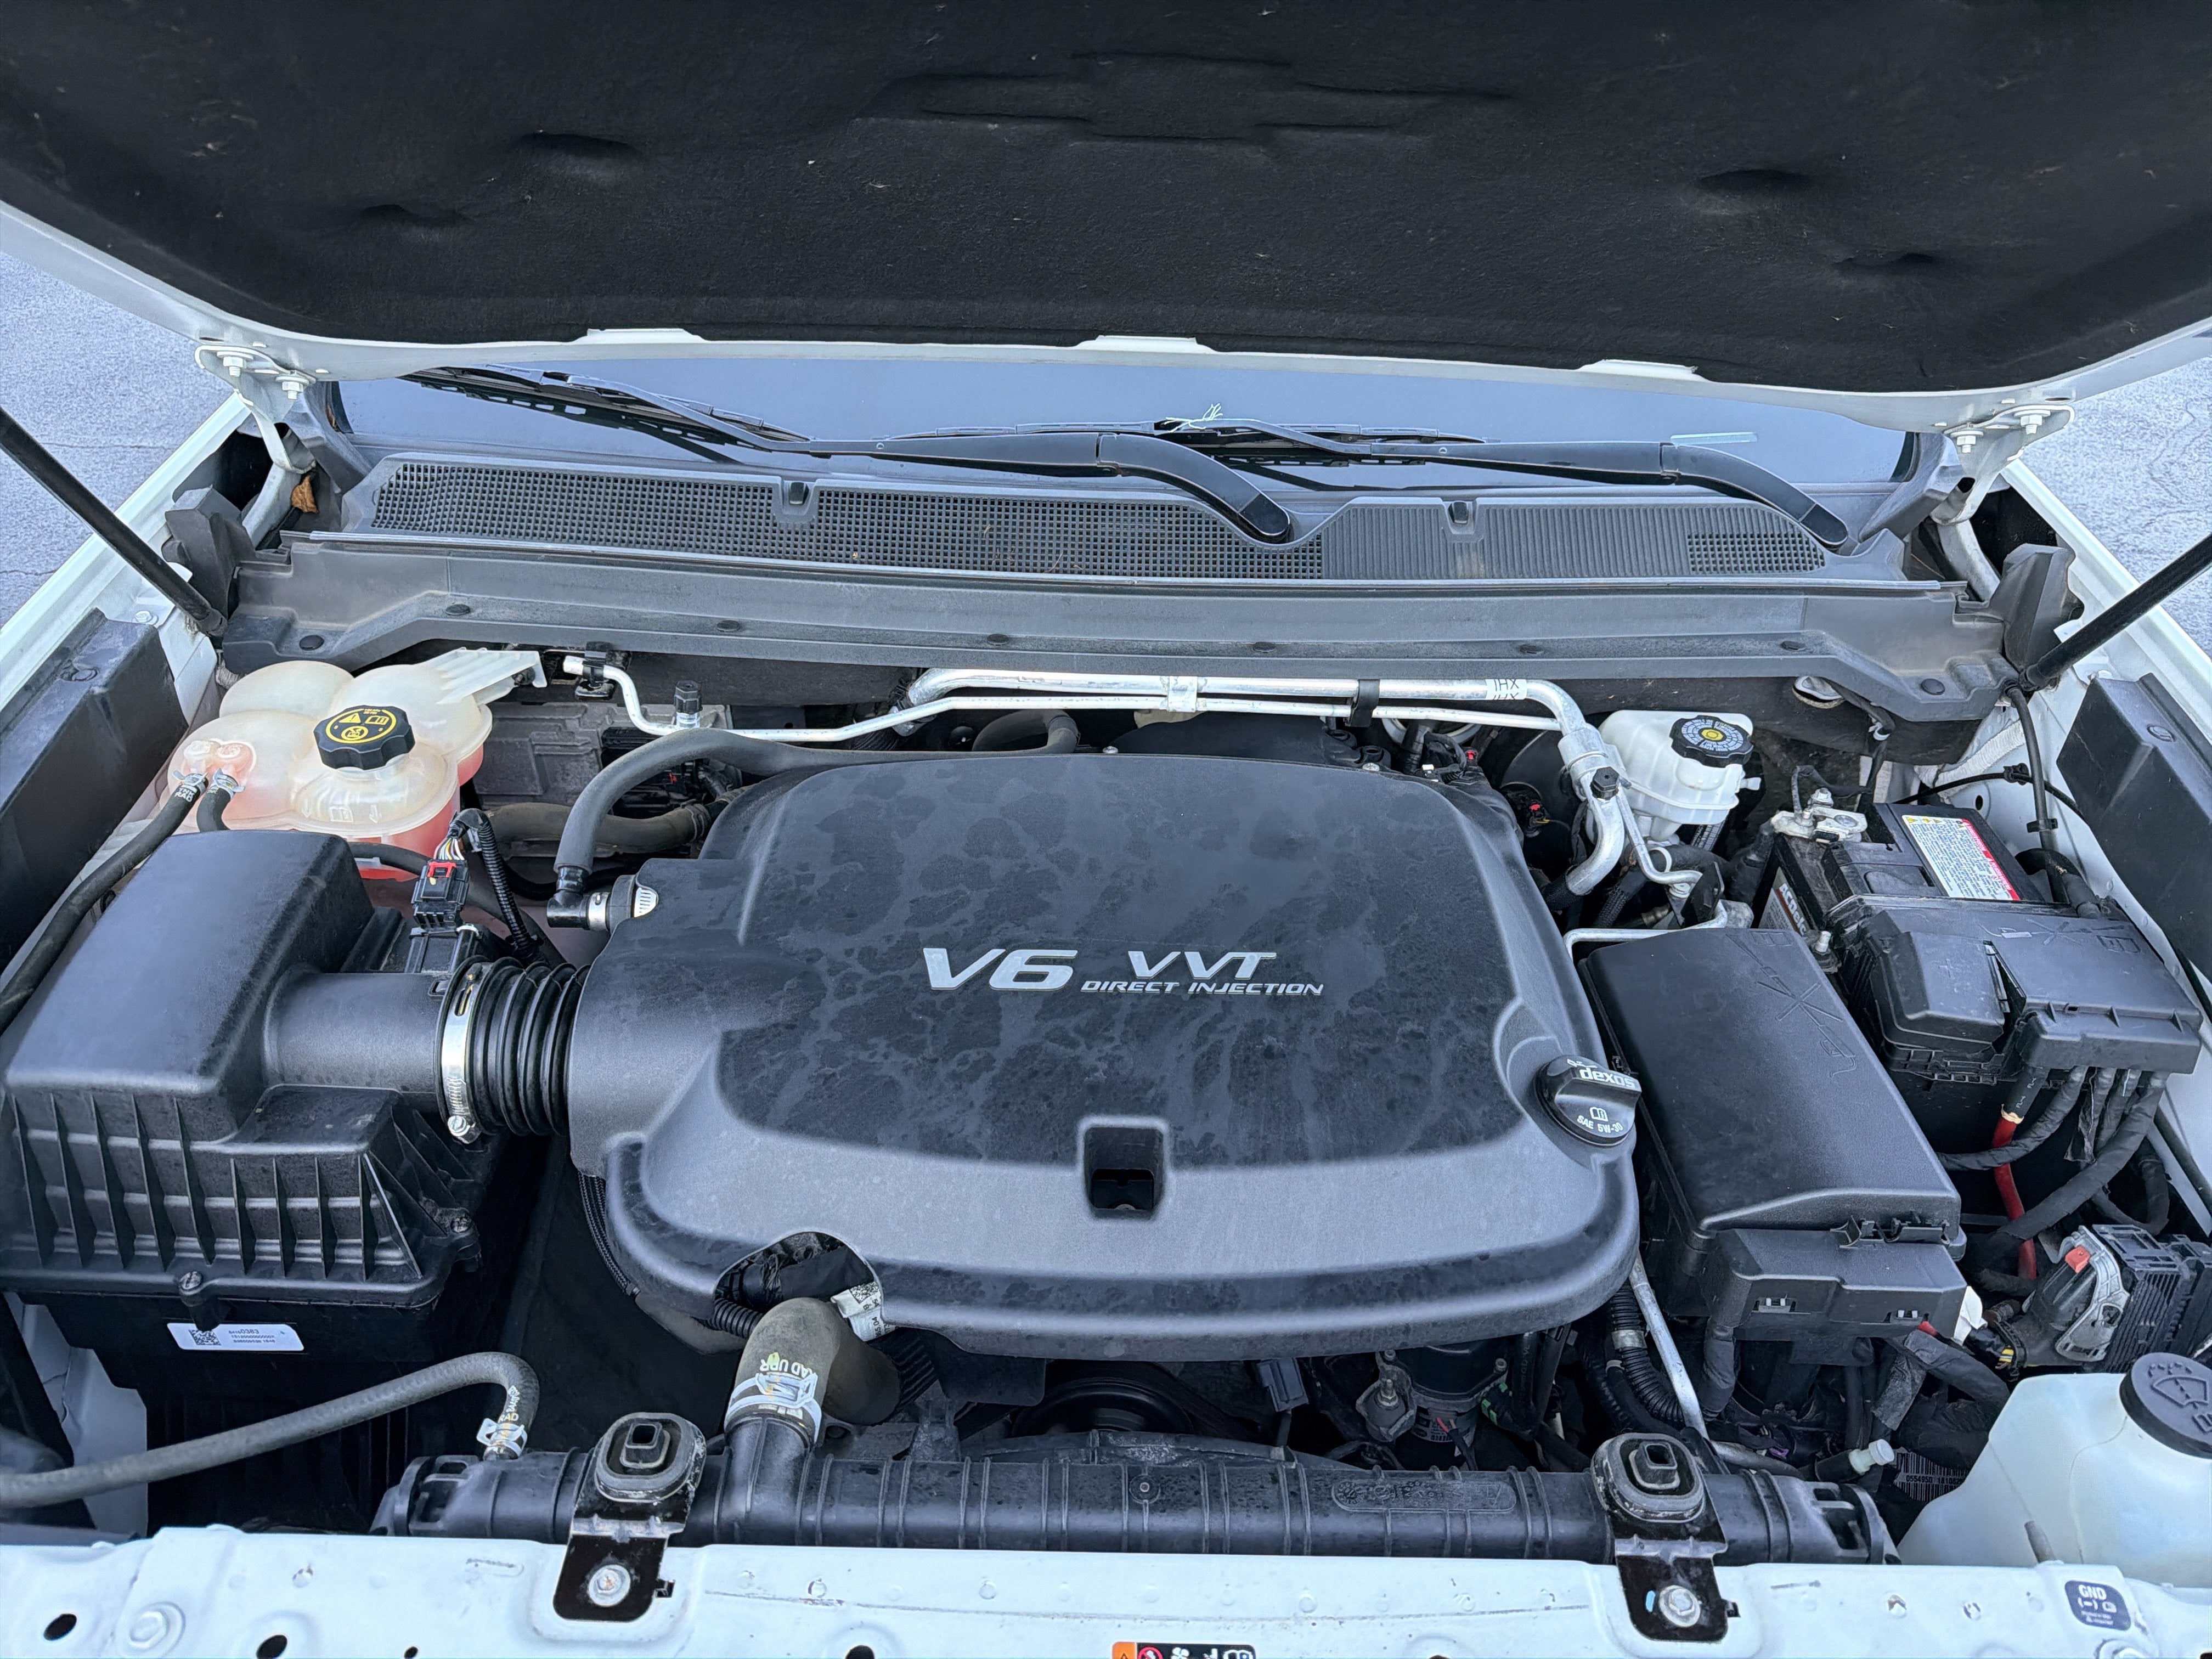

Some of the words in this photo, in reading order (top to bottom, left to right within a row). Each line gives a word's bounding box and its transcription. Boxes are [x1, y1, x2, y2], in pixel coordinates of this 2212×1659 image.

[1779, 883, 1807, 936] ACDelc
[923, 947, 1077, 990] V6
[1128, 951, 1277, 979] VVT
[1081, 980, 1180, 994] DIRECT
[1188, 982, 1323, 995] INJECTION
[1580, 1068, 1635, 1088] dexos
[1577, 1115, 1594, 1130] SAE
[1598, 1122, 1623, 1133] 5W-30
[497, 1412, 519, 1424] RAD
[2078, 1584, 2107, 1600] GND
